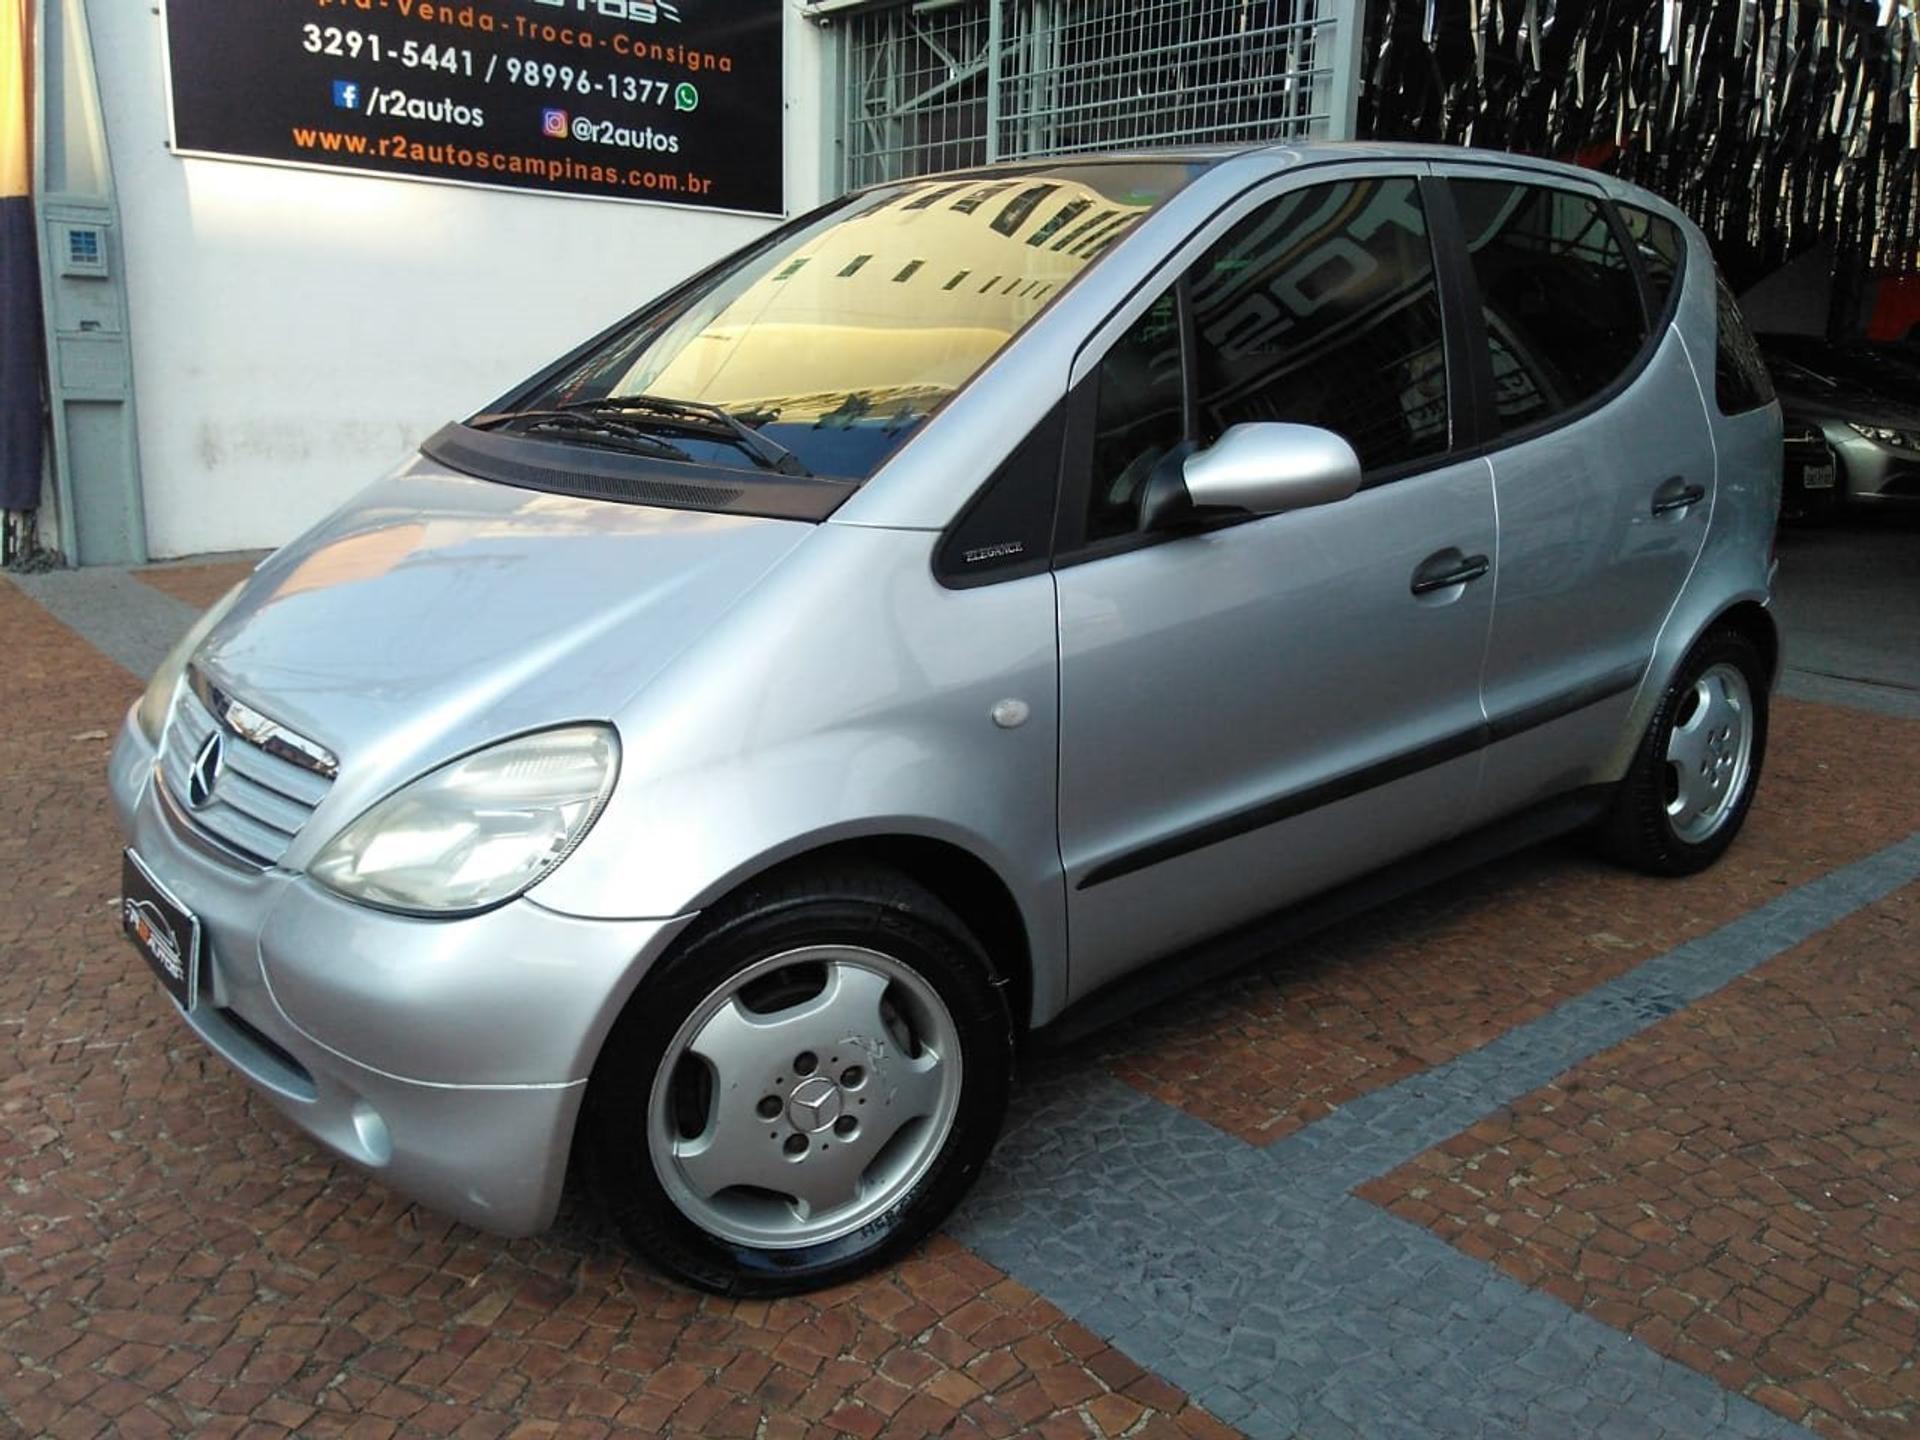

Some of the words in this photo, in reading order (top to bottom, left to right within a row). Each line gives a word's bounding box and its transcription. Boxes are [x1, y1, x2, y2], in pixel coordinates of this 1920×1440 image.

[303, 23, 473, 76] 3291-5441
[506, 57, 669, 106] 98996-1377
[366, 86, 485, 127] /r2autos
[572, 117, 679, 153] @r2autos
[293, 128, 712, 194] www.r2autoscampinas.com.br
[965, 543, 1023, 562] ELEGANCE
